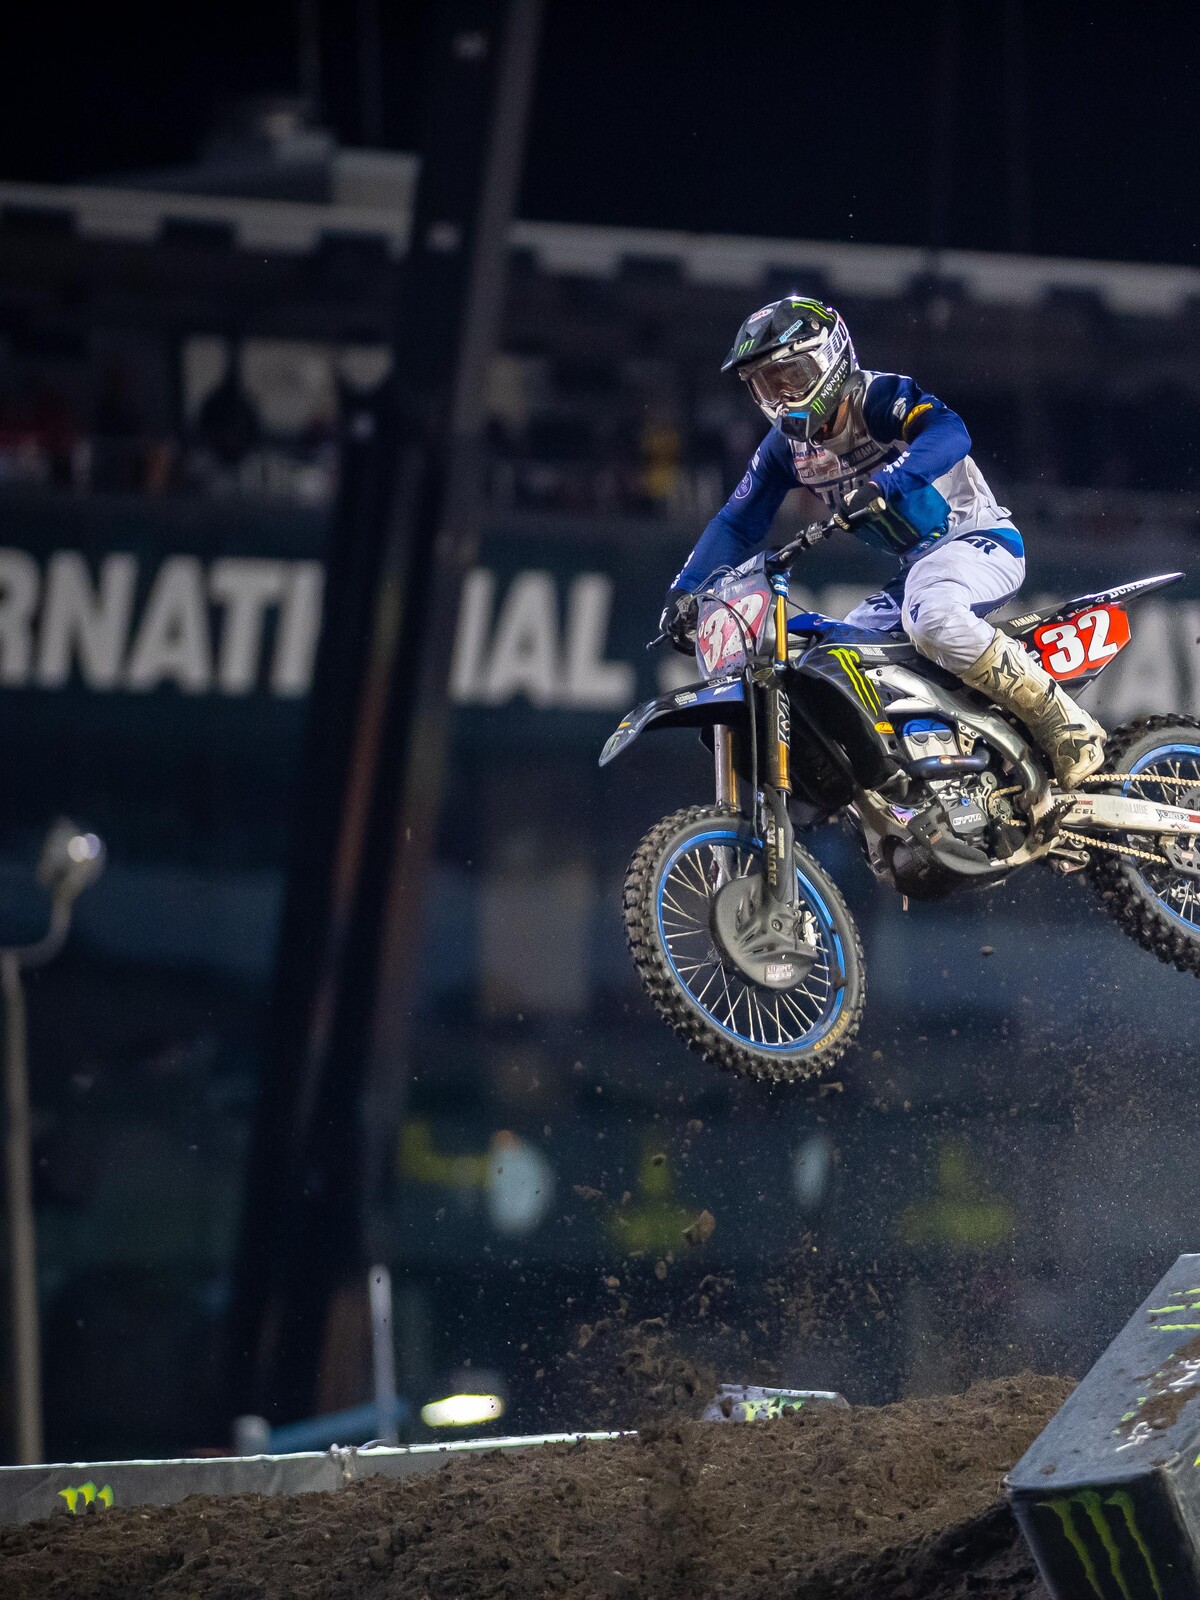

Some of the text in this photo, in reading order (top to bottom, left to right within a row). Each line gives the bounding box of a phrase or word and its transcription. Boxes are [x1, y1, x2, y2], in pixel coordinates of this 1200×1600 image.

[1009, 613, 1042, 628] YAMAHA
[1040, 609, 1118, 673] 32
[812, 1010, 849, 1051] DUNLOP
